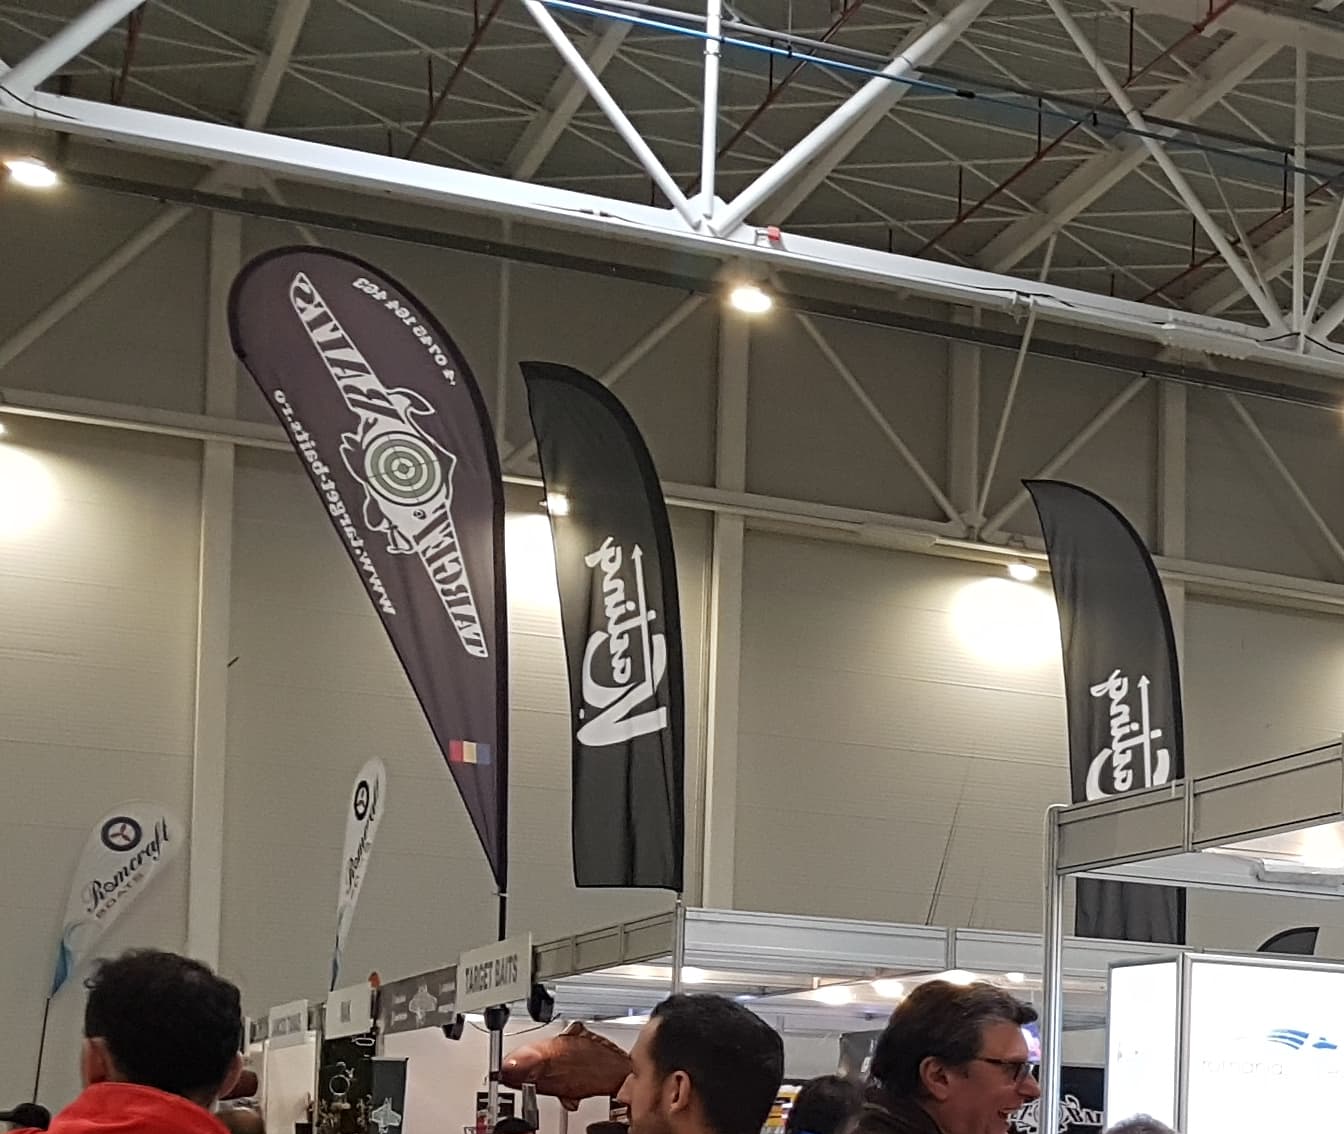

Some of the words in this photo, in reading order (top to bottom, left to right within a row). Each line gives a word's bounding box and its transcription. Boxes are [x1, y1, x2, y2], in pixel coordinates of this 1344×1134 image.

[87, 815, 169, 913] Romcraft
[465, 960, 493, 994] TARGET
[494, 954, 518, 987] BAITS
